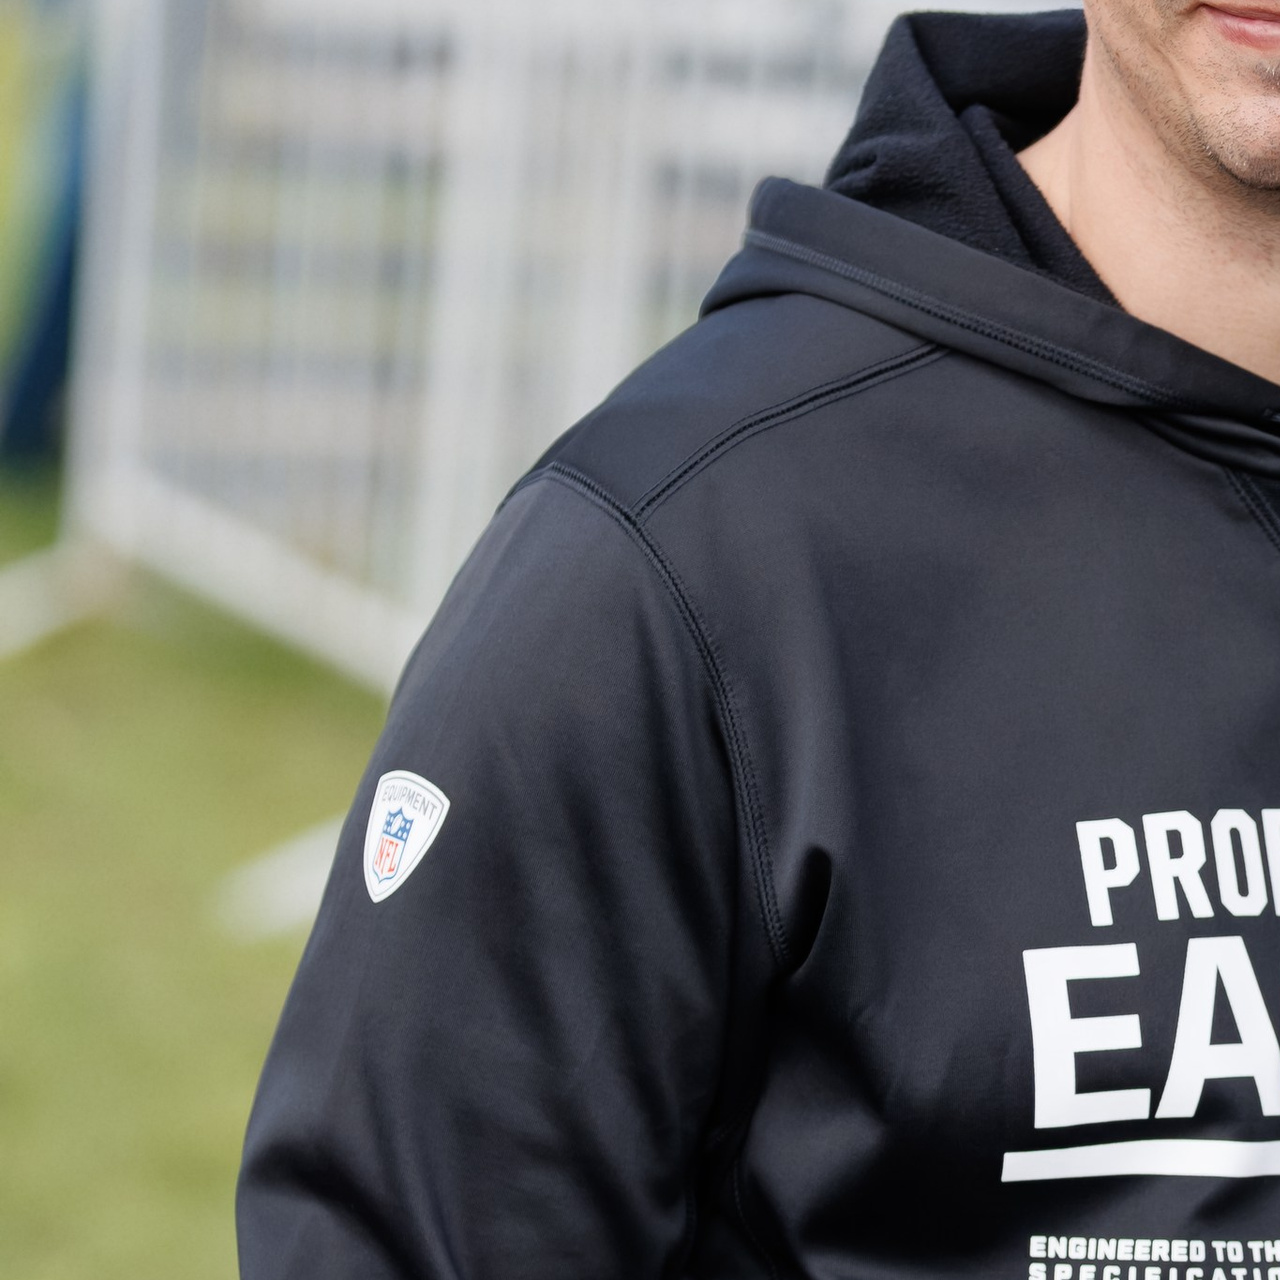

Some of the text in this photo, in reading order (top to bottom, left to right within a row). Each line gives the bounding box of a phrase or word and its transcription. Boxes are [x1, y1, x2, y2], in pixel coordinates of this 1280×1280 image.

[381, 784, 438, 821] EQUIPMENT
[374, 836, 399, 875] NFL
[1029, 1235, 1206, 1263] ENGINEERED
[1211, 1239, 1244, 1263] TO
